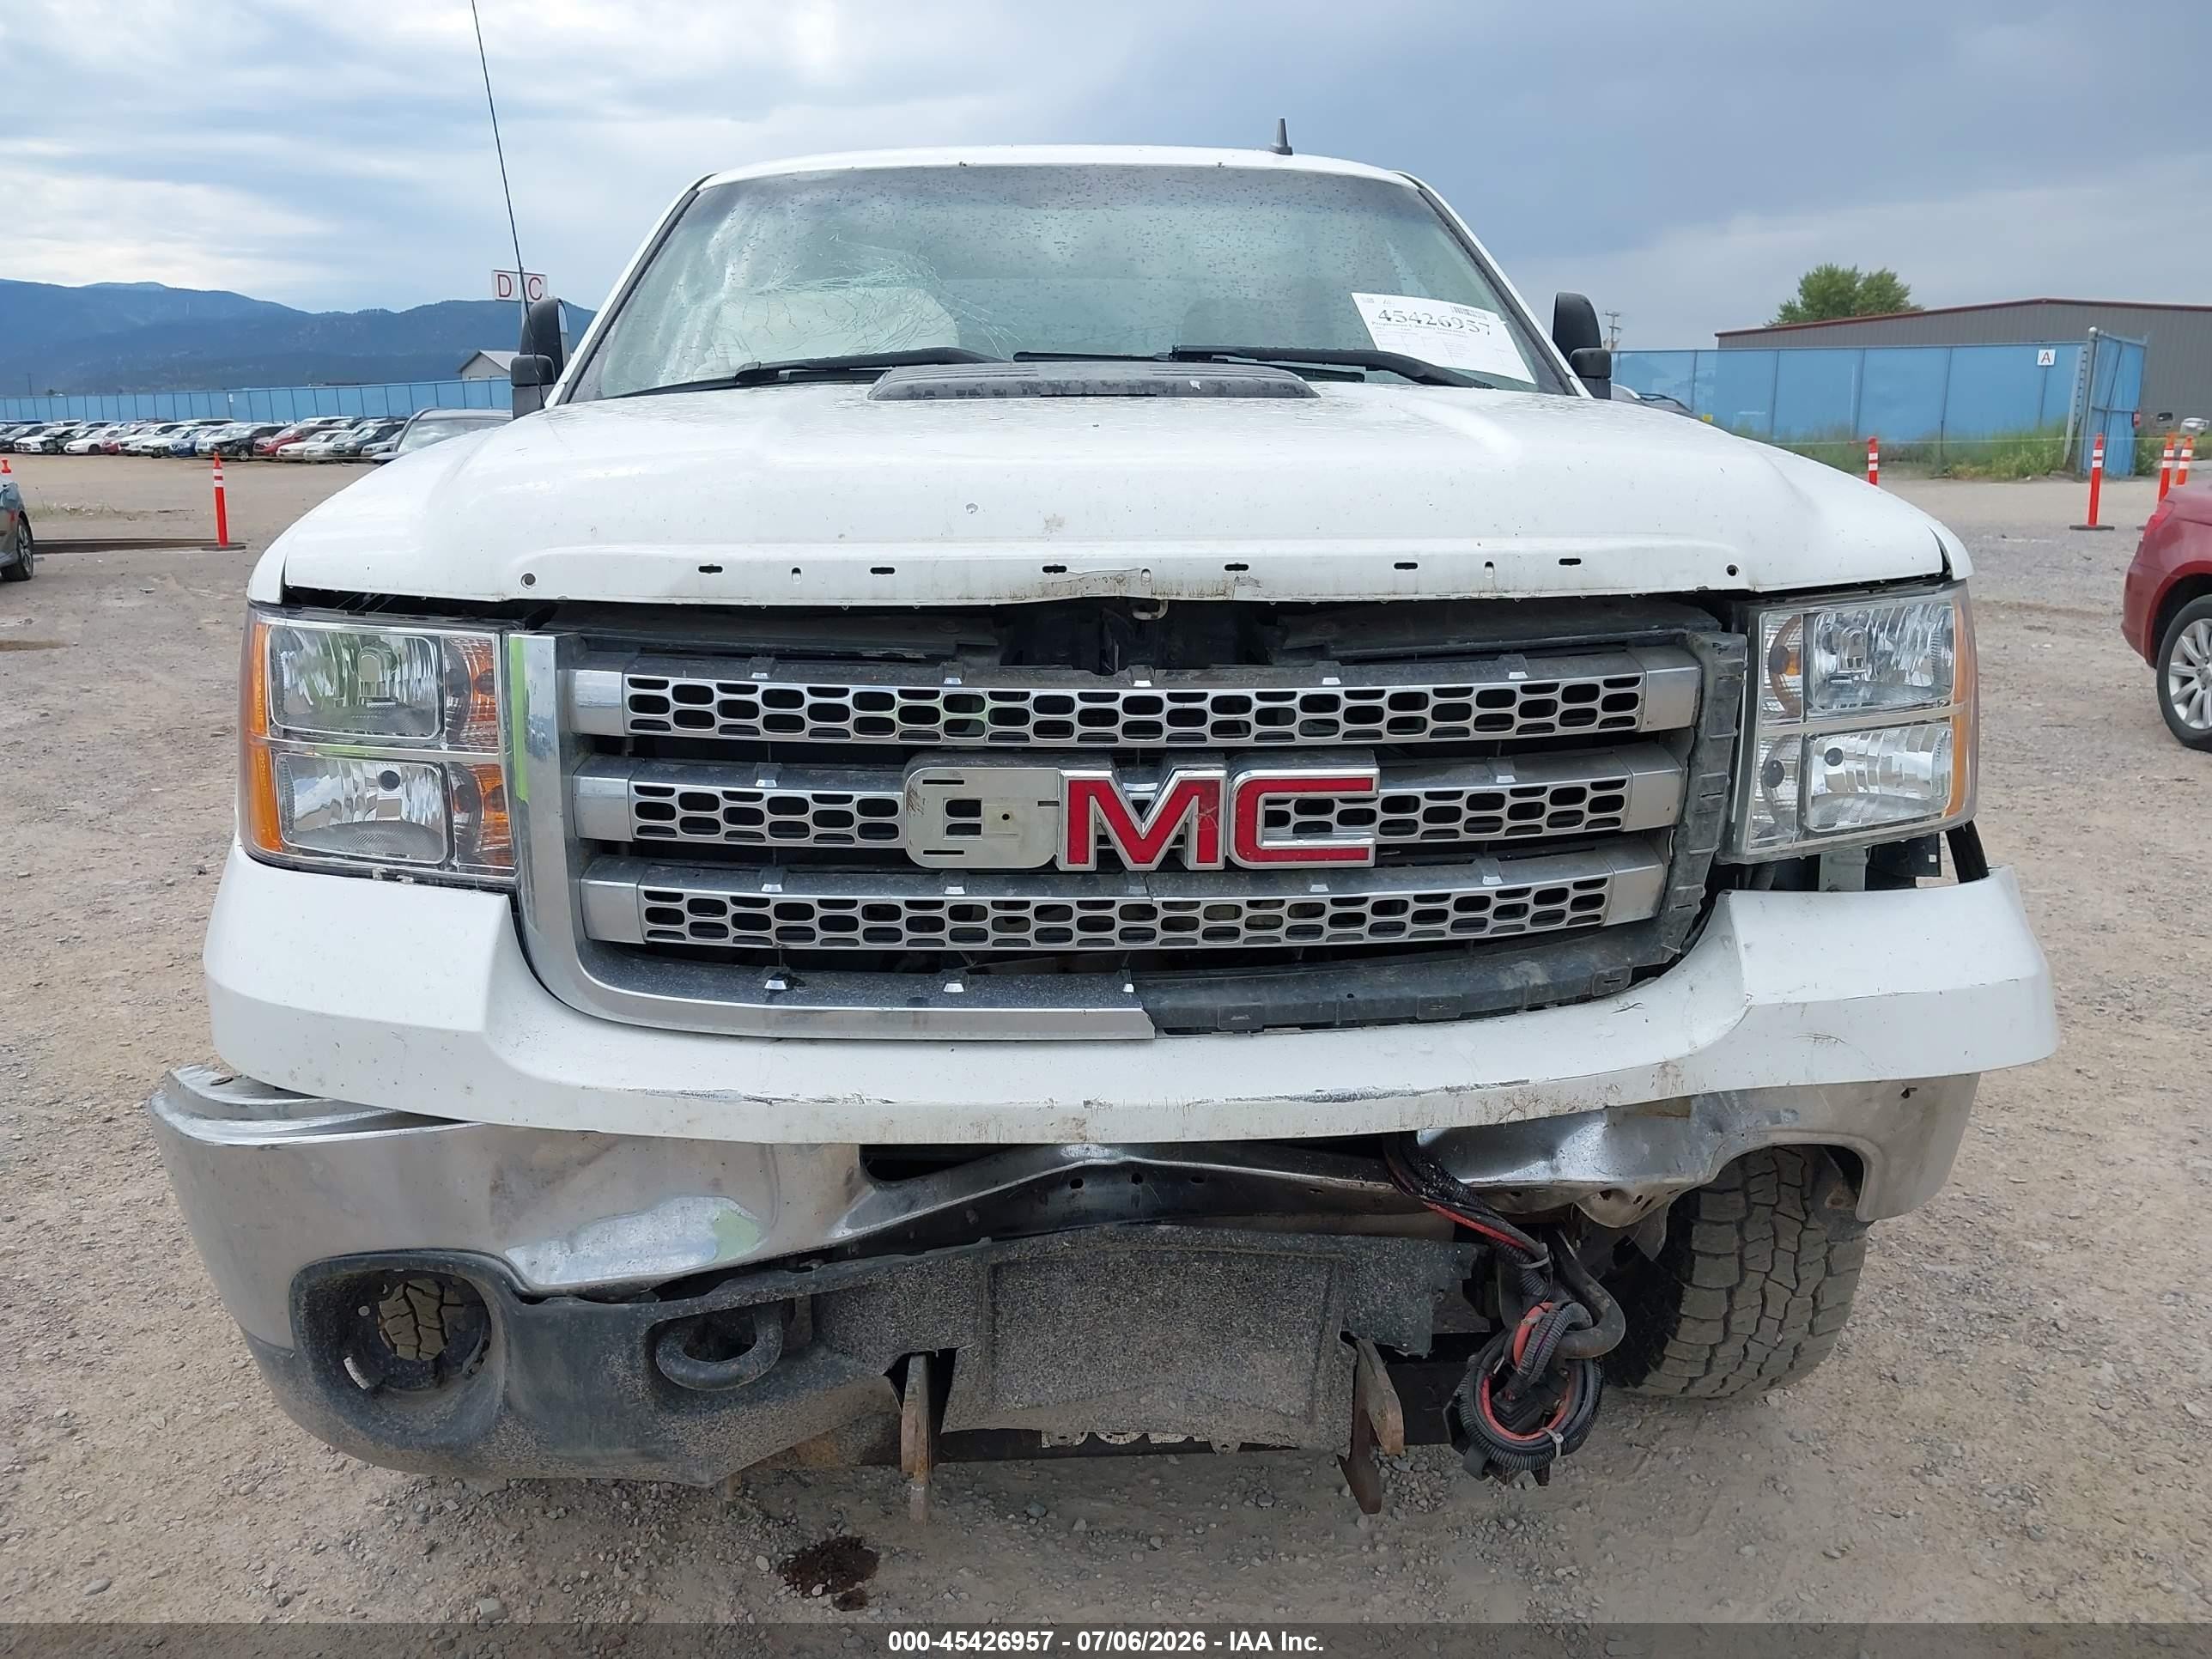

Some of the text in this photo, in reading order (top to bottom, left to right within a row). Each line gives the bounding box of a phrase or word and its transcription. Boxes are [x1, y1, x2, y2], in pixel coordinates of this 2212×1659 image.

[497, 274, 543, 301] D C
[1377, 309, 1491, 336] 45426957
[2040, 351, 2051, 364] A
